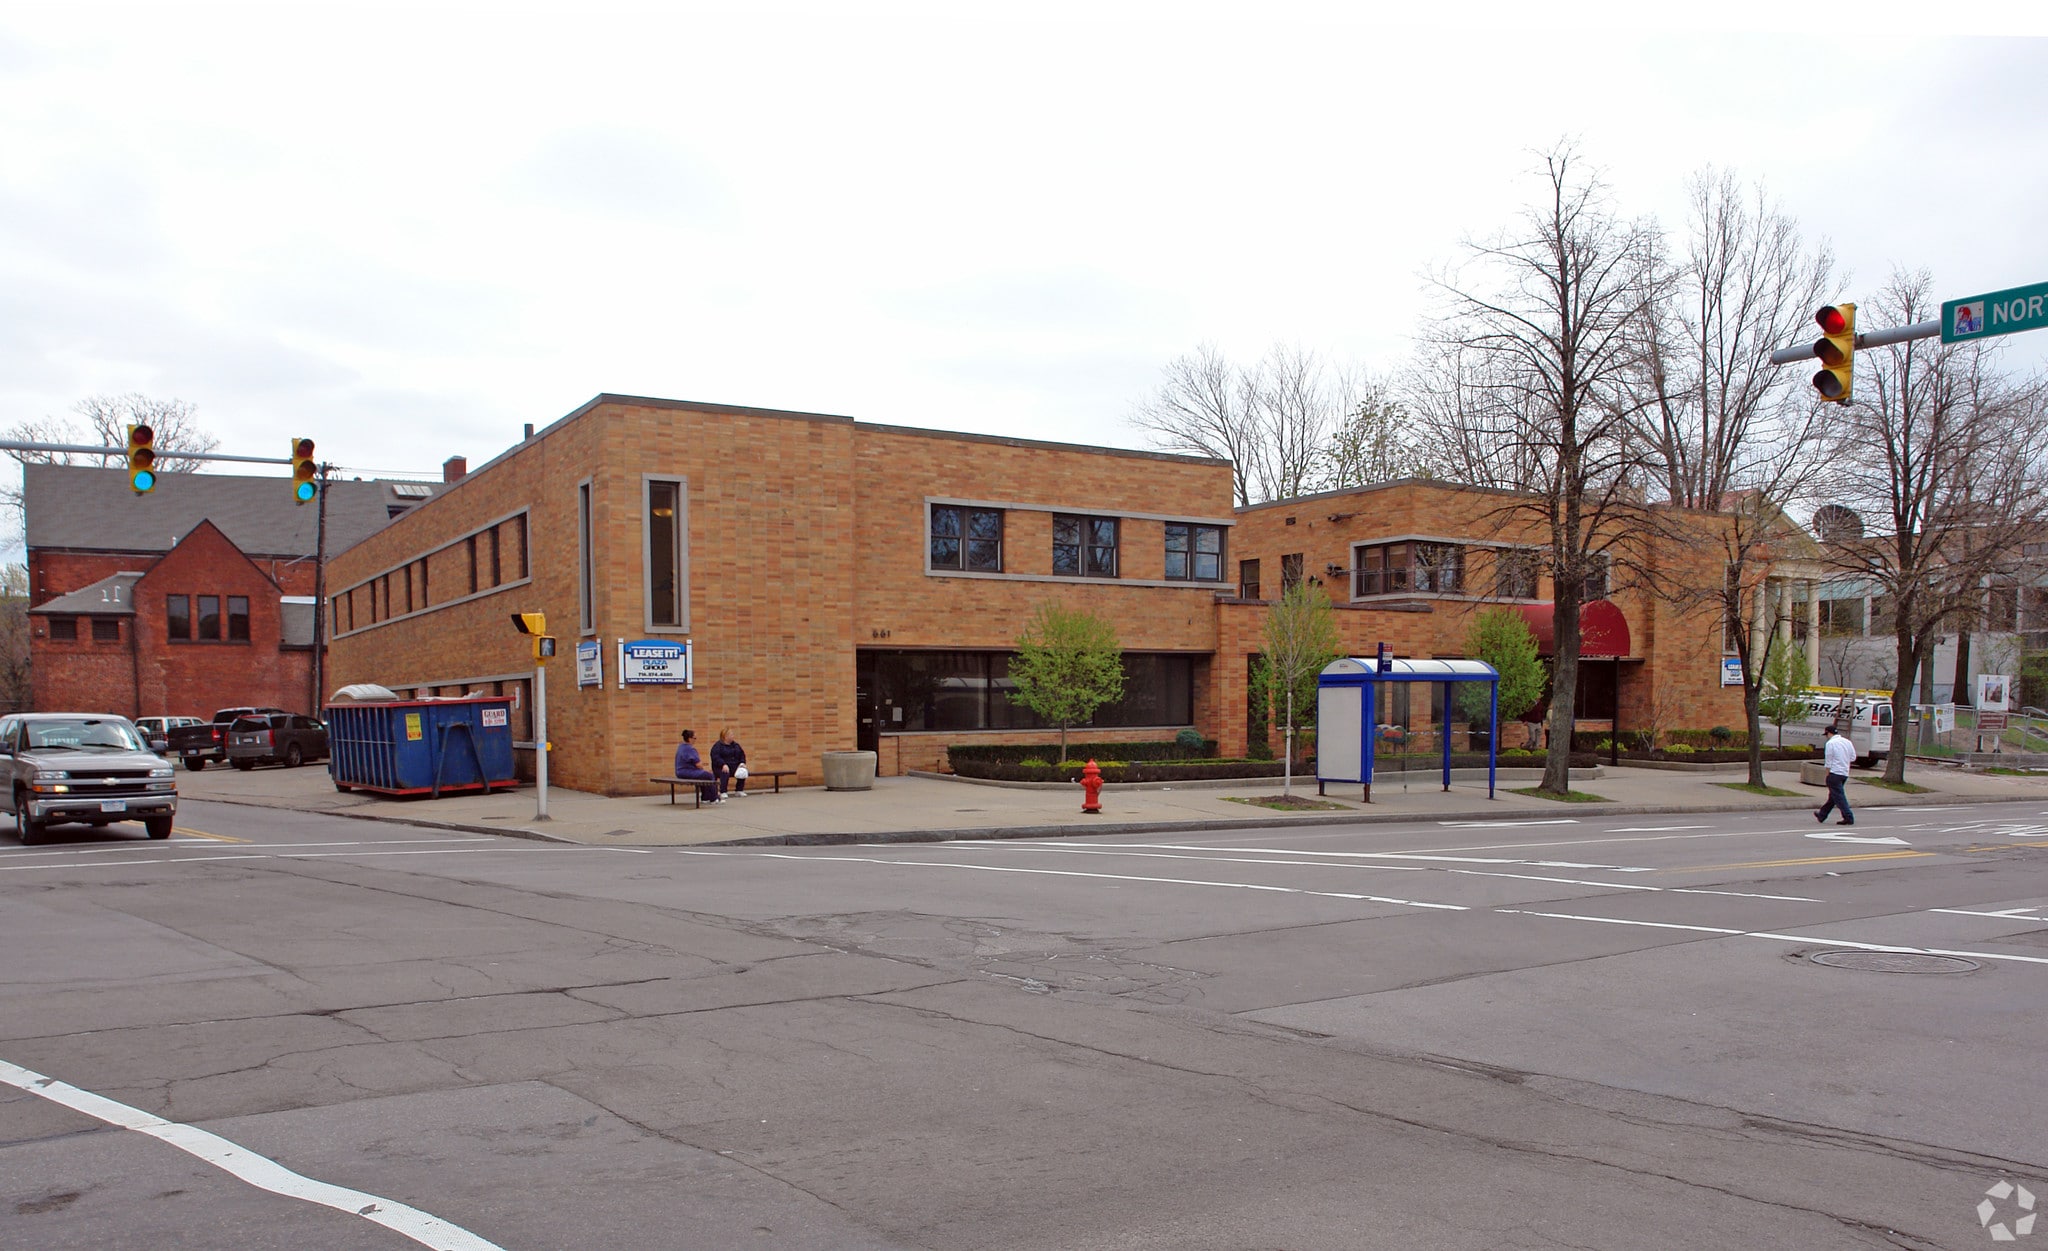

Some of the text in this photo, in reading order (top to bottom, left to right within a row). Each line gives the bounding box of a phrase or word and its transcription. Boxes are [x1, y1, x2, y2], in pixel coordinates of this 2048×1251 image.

[1993, 294, 2048, 325] NOR
[872, 629, 891, 639] 661
[633, 649, 678, 658] LEASE IT!
